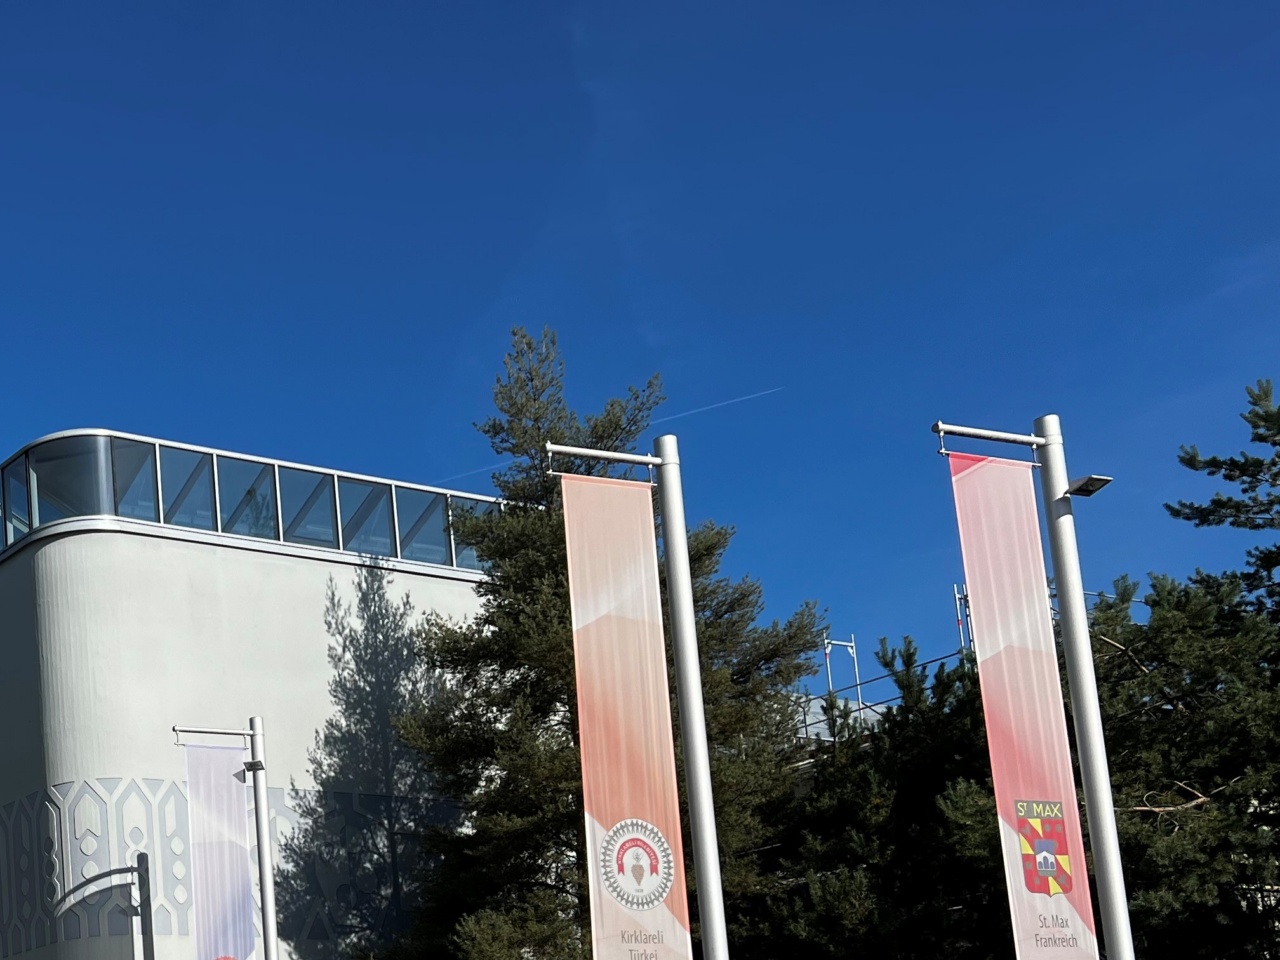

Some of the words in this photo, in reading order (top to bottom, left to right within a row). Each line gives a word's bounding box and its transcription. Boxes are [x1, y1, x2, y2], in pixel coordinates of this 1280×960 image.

[1032, 803, 1063, 818] MAX
[1039, 914, 1050, 929] St.
[1051, 915, 1070, 929] Max
[620, 930, 665, 945] Kirklareli
[1034, 933, 1078, 948] Frankreich
